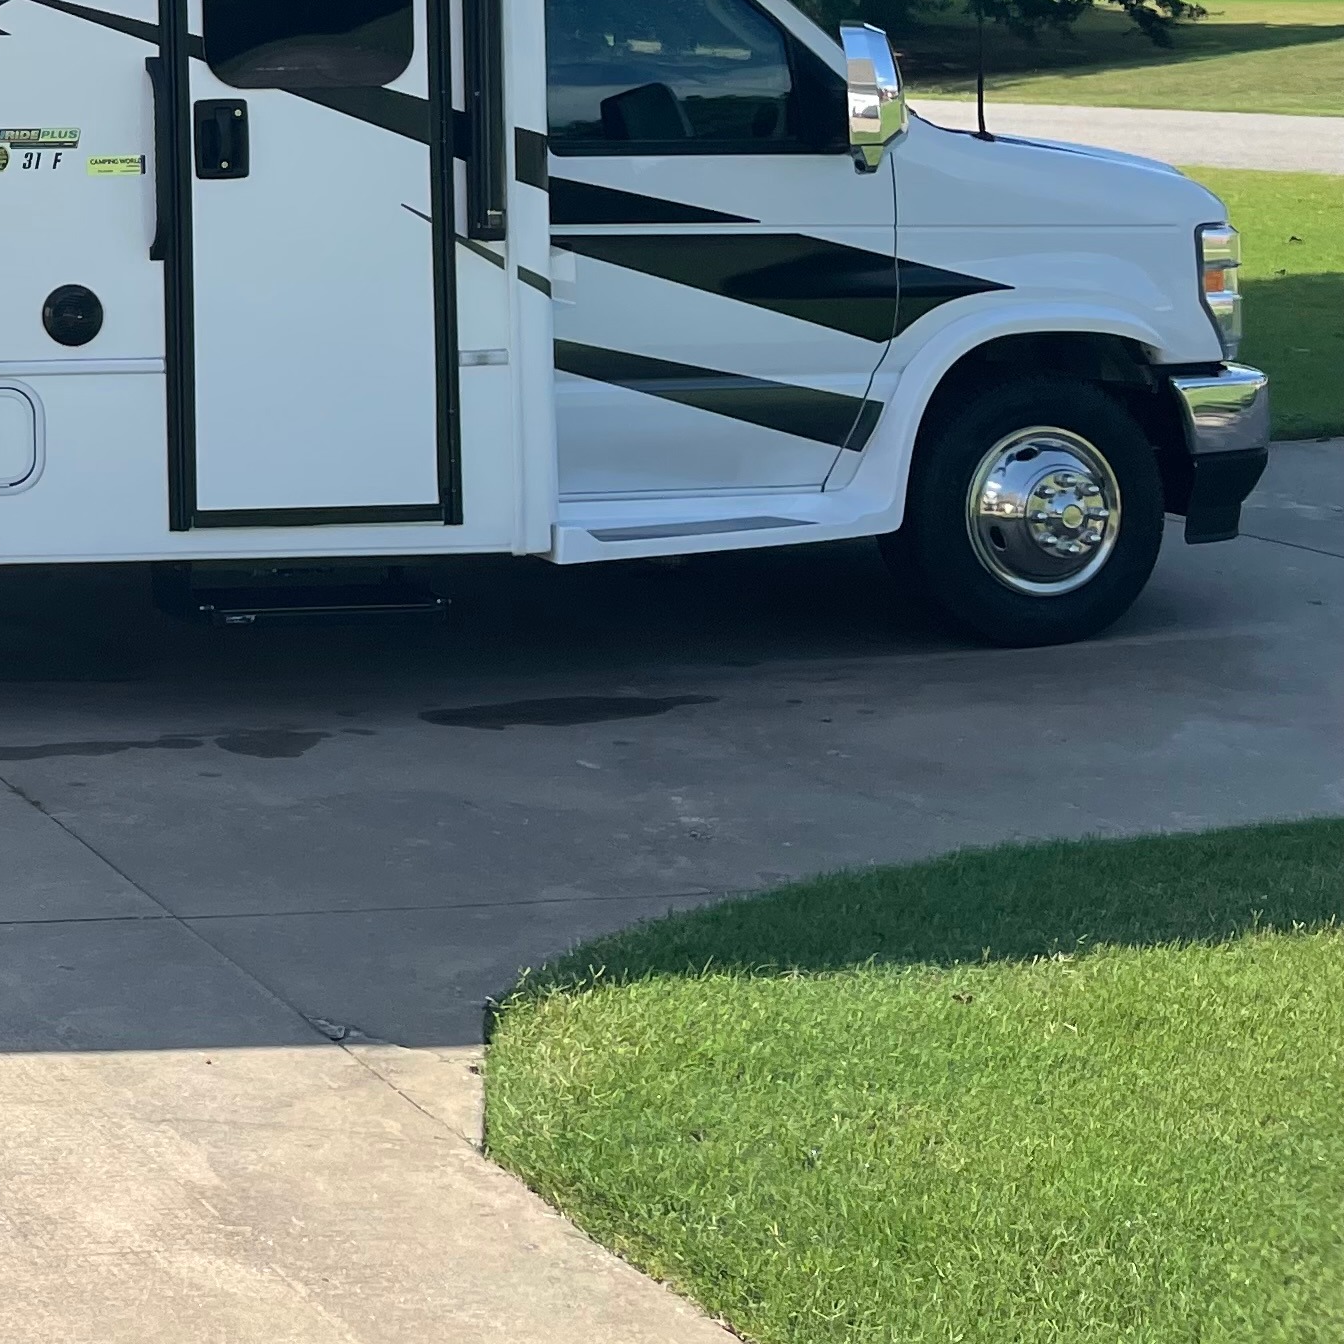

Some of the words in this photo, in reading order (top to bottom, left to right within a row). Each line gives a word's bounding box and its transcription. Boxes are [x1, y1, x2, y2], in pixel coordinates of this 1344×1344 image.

[41, 129, 79, 139] PLUS
[22, 152, 41, 169] 31
[52, 152, 63, 169] F
